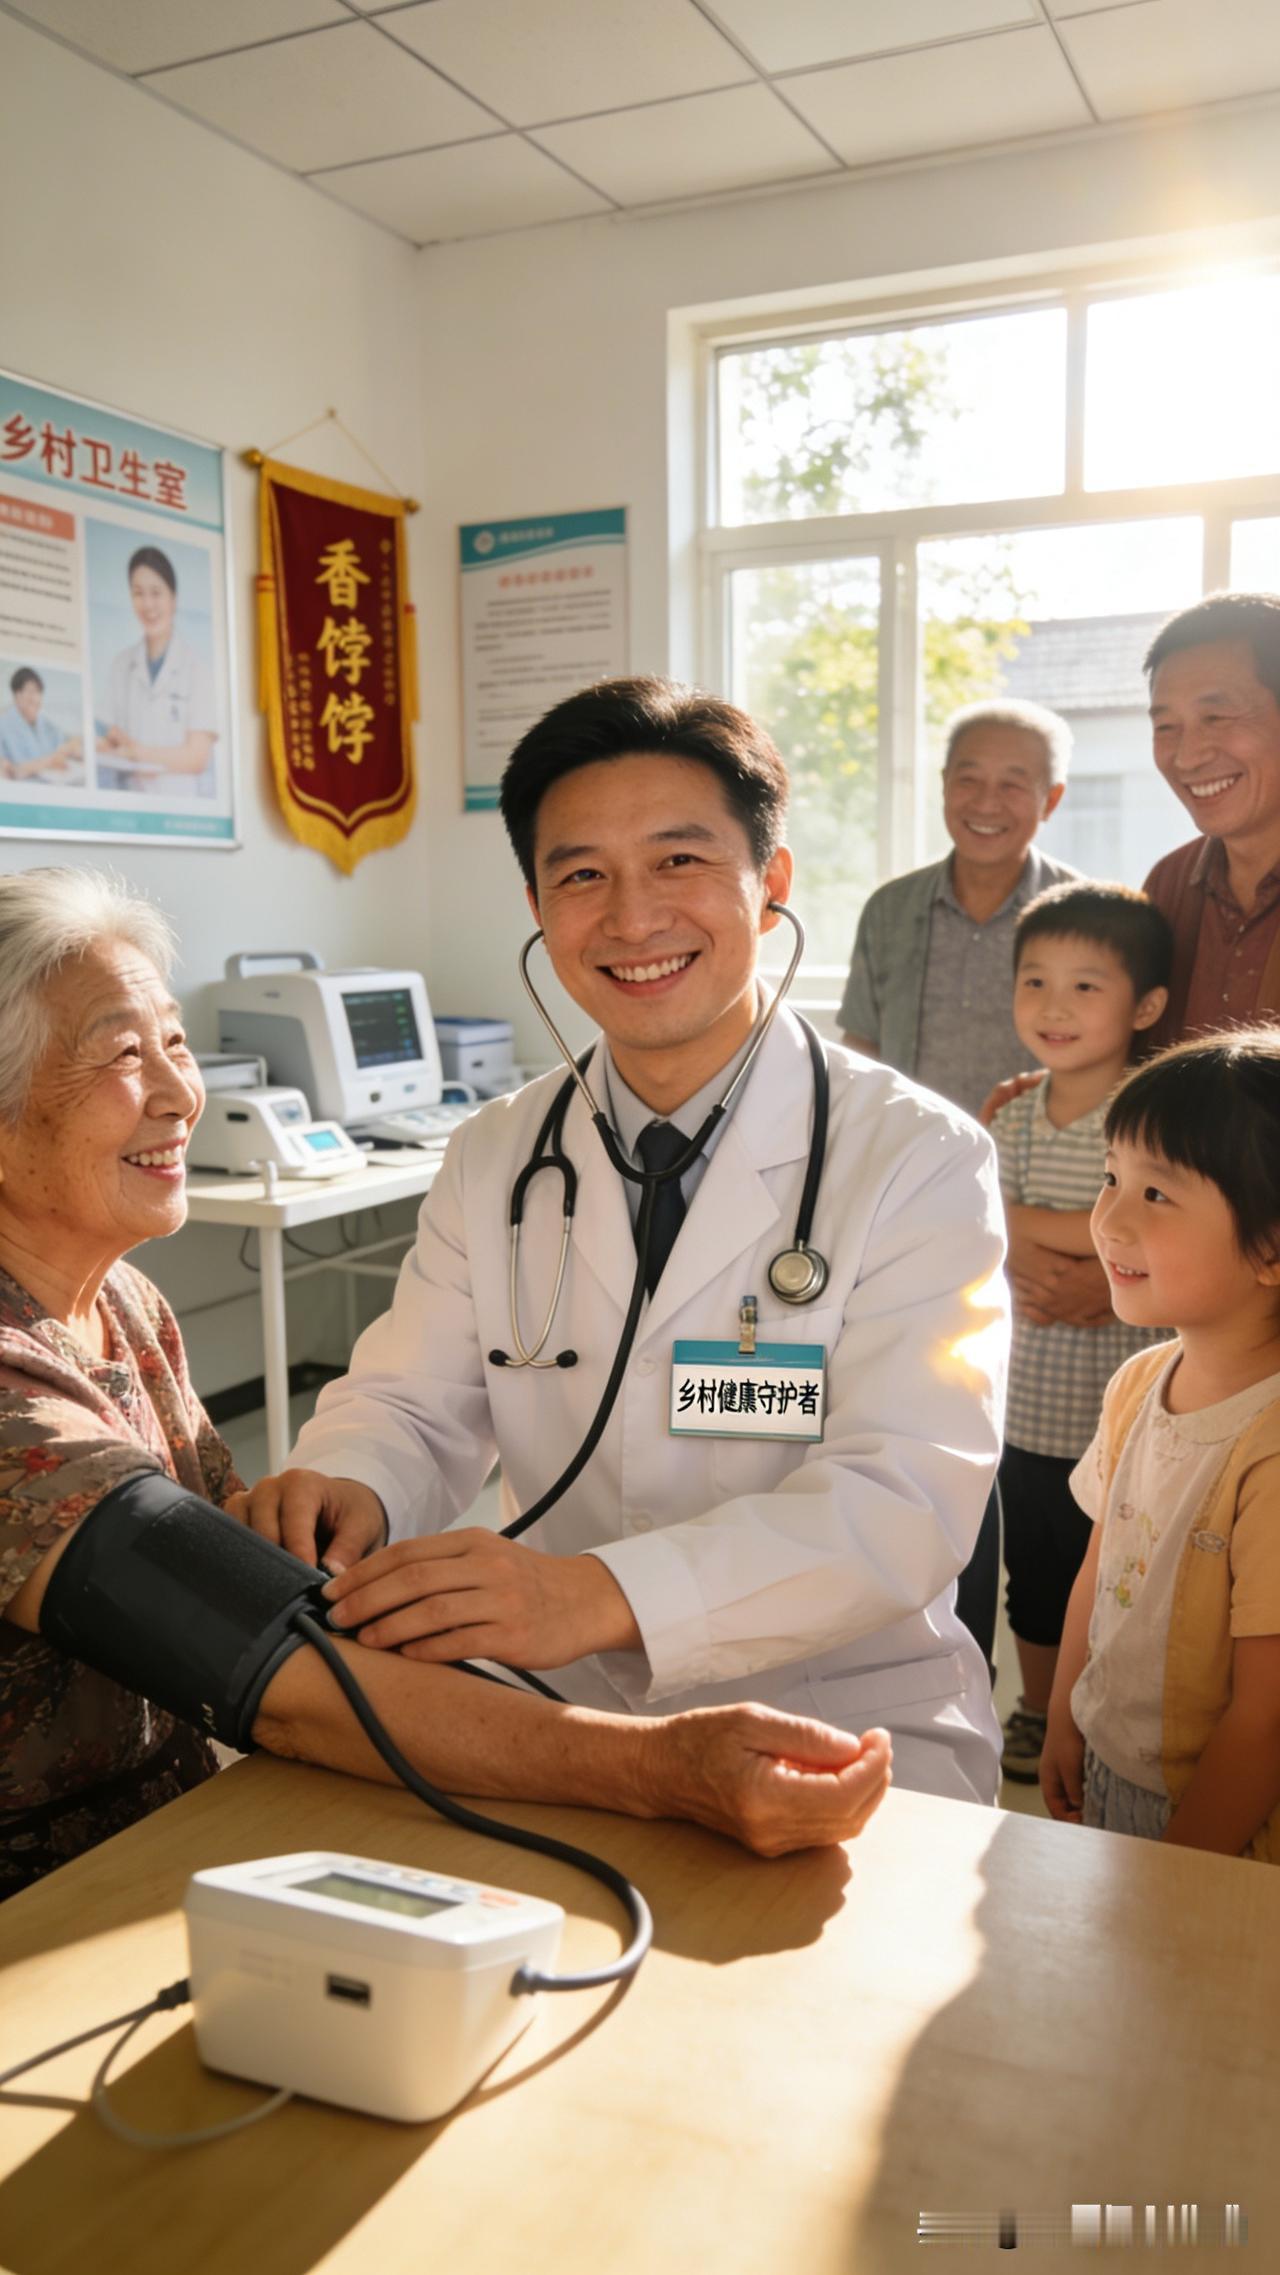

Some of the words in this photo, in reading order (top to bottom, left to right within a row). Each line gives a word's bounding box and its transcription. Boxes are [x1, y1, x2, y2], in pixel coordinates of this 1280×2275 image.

[0, 414, 187, 510] 乡村卫生室
[314, 538, 375, 765] 香饽饽
[677, 1378, 820, 1416] 乡村健康守护者
